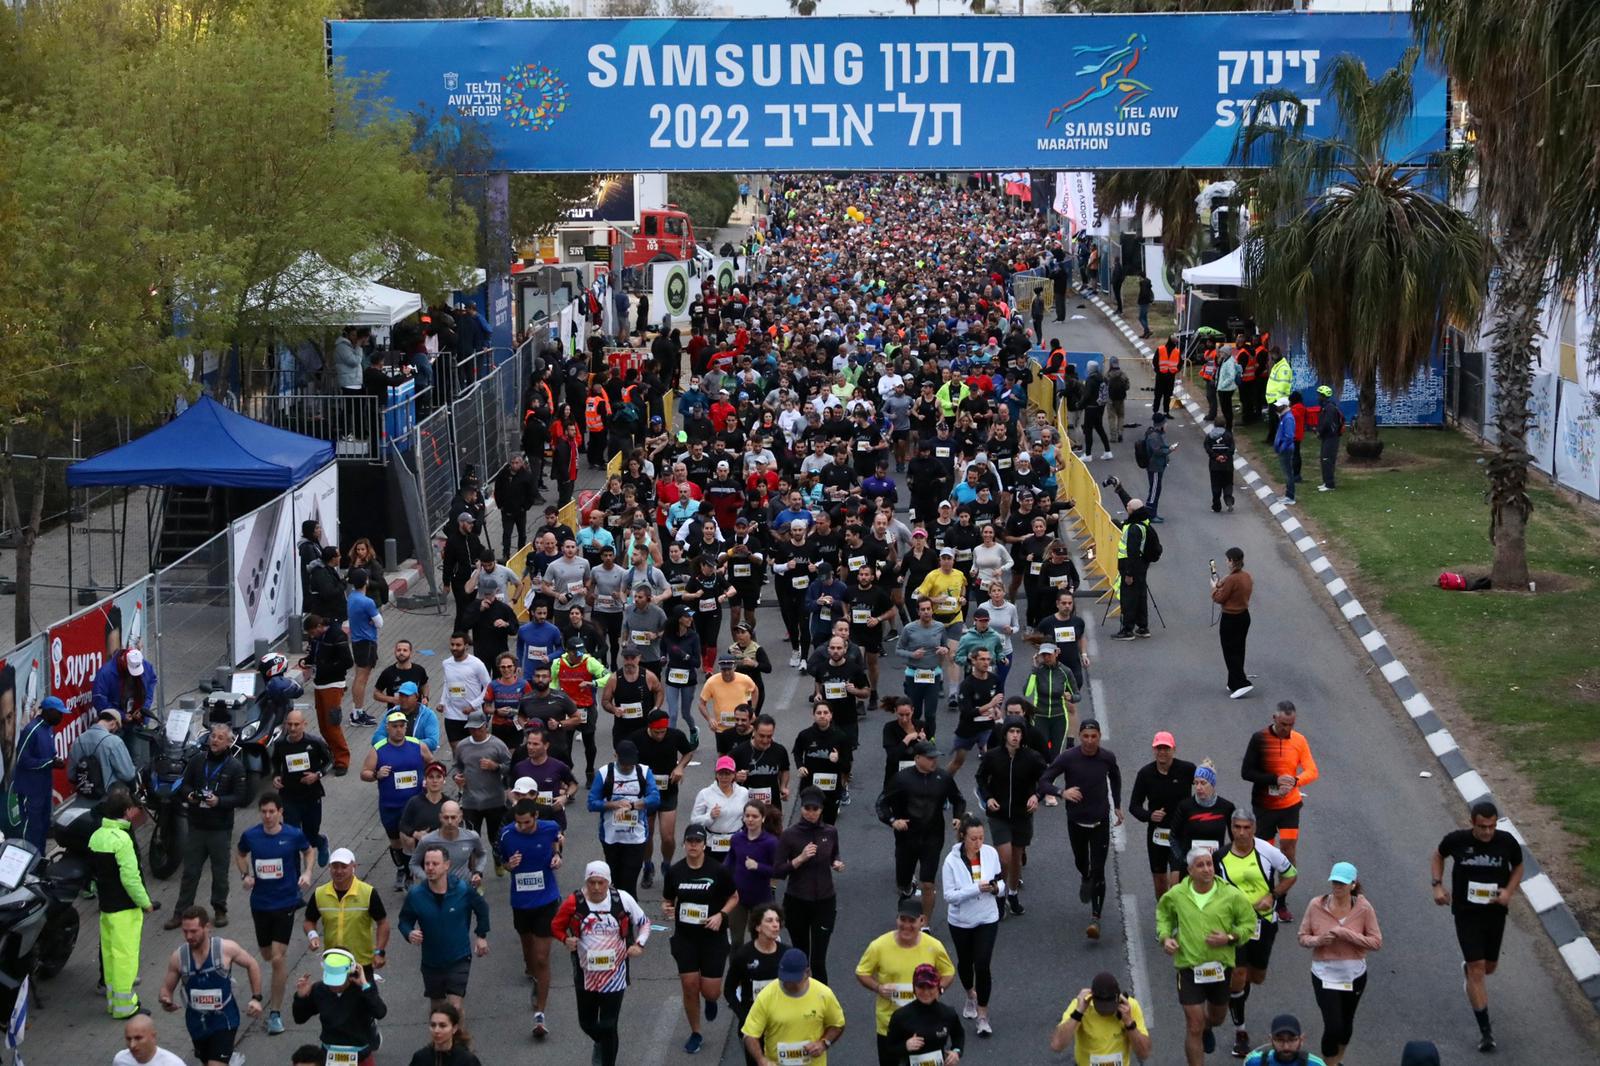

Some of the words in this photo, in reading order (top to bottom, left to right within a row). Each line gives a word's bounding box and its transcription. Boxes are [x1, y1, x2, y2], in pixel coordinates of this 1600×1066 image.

[587, 43, 864, 88] SAMSUNG
[880, 43, 1015, 91] מרתון
[1217, 50, 1320, 94] זינוק
[465, 83, 485, 93] TEL
[485, 80, 501, 93] תל
[448, 94, 473, 105] AVIV
[473, 94, 501, 105] אביב
[486, 106, 502, 116] יפו
[1122, 106, 1146, 118] TEL
[1149, 106, 1179, 118] AVIV
[1215, 98, 1321, 127] START
[649, 103, 749, 148] 2022
[1065, 122, 1151, 137] SAMSUNG
[1037, 138, 1109, 150] MARATHON
